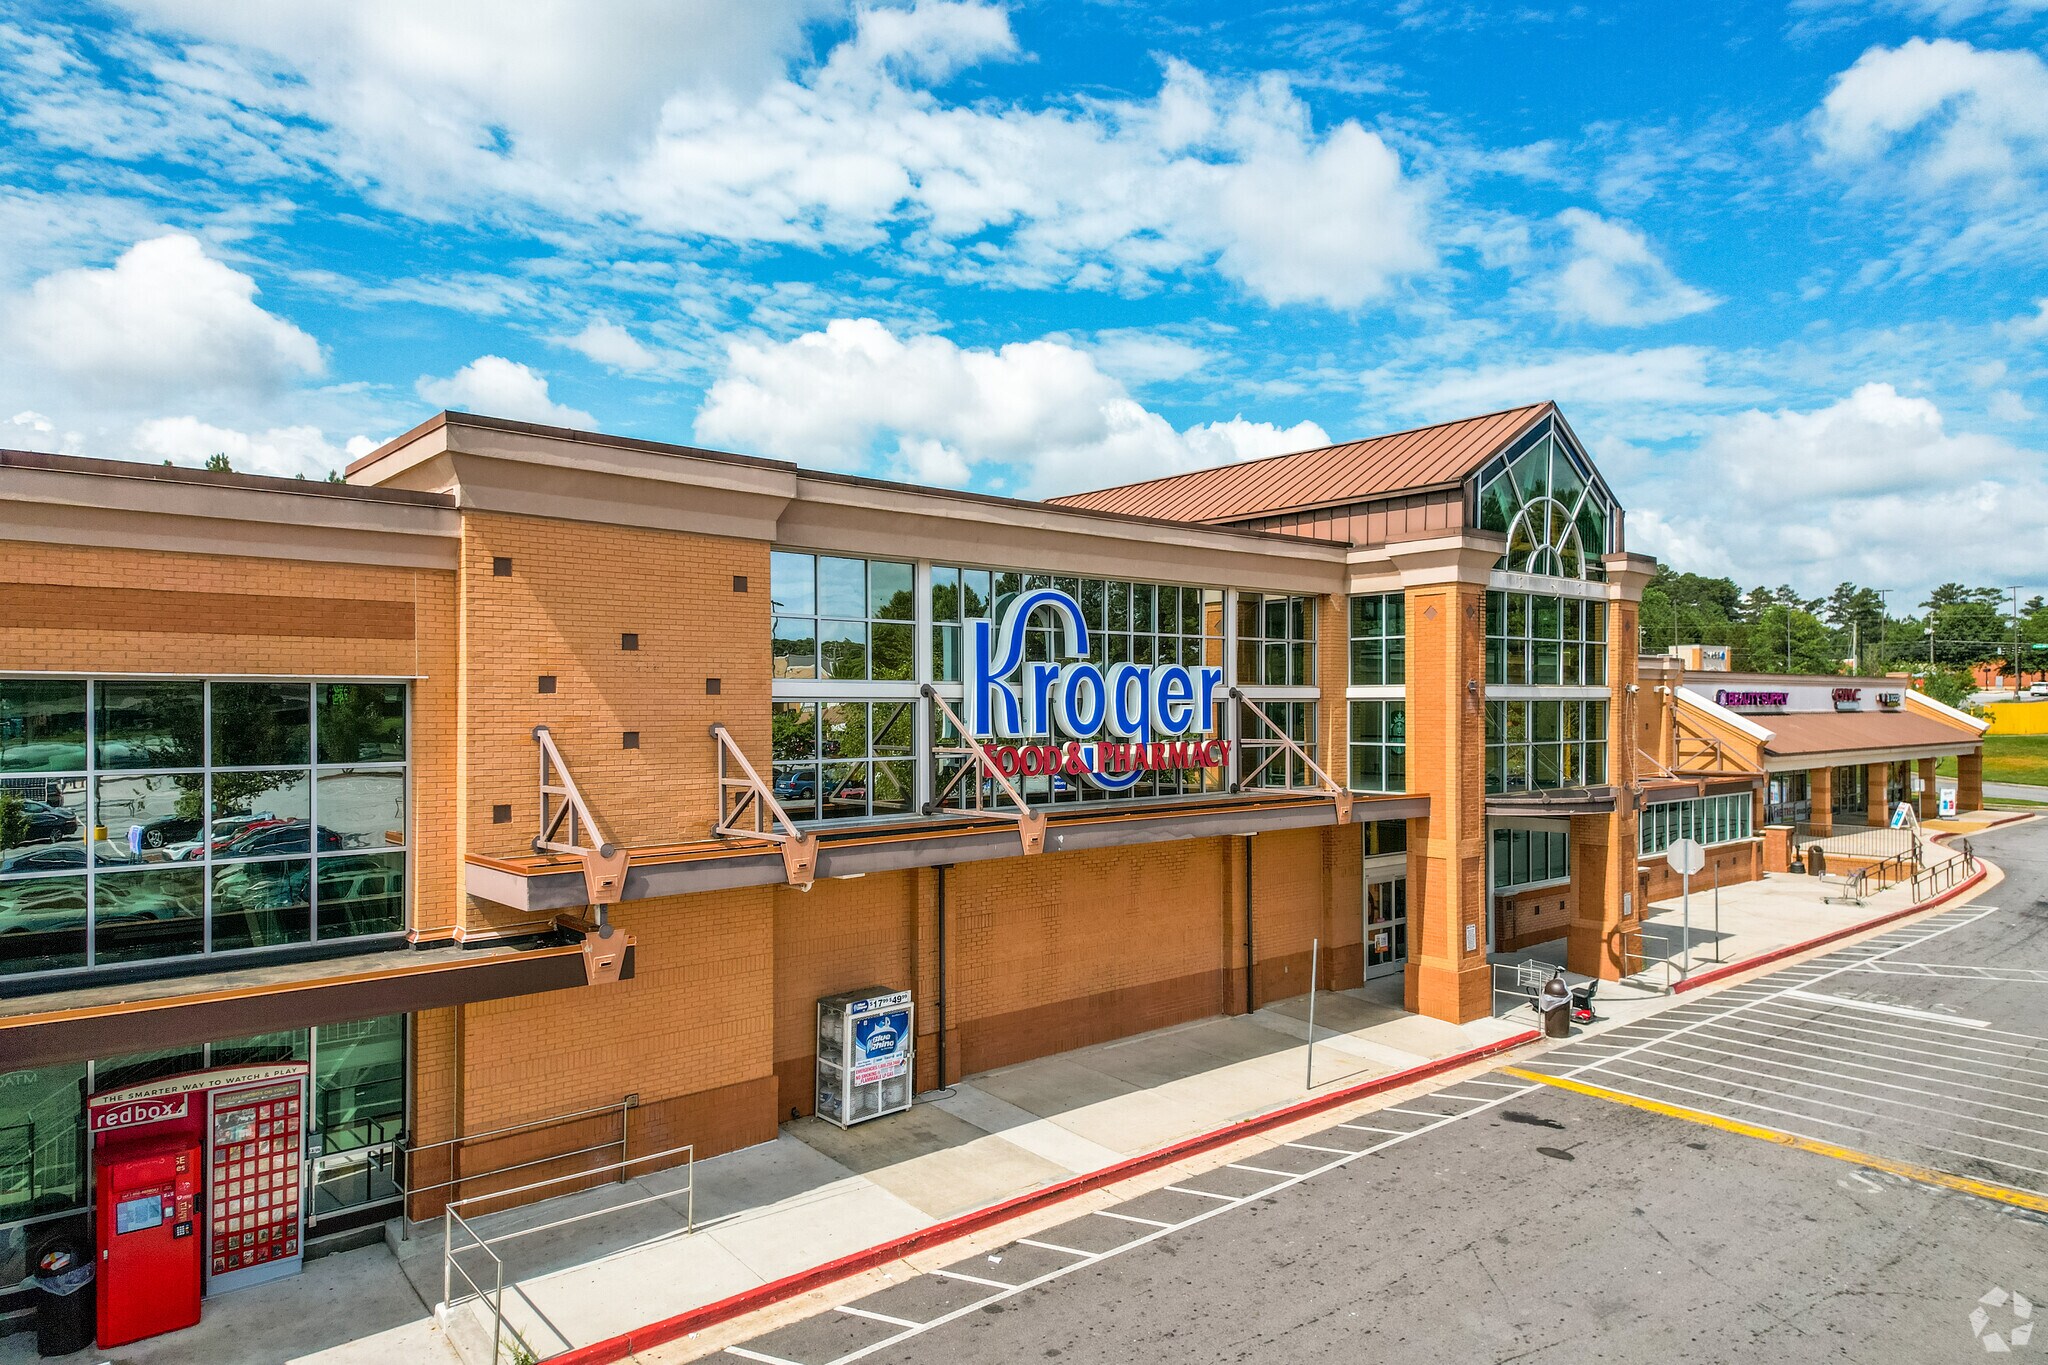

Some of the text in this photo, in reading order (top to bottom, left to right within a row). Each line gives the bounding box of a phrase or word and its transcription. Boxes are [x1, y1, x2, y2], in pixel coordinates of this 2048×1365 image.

[964, 589, 1223, 791] Kroger
[1728, 692, 1789, 705] BEAUTY SUPPLY
[982, 740, 1232, 778] FOOD & PHARMACY
[102, 1094, 123, 1103] THE
[128, 1086, 178, 1099] SMARTER
[182, 1082, 205, 1090] WAY
[226, 1073, 260, 1084] WATCH
[274, 1067, 298, 1076] PLAY
[97, 1103, 174, 1127] redbox
